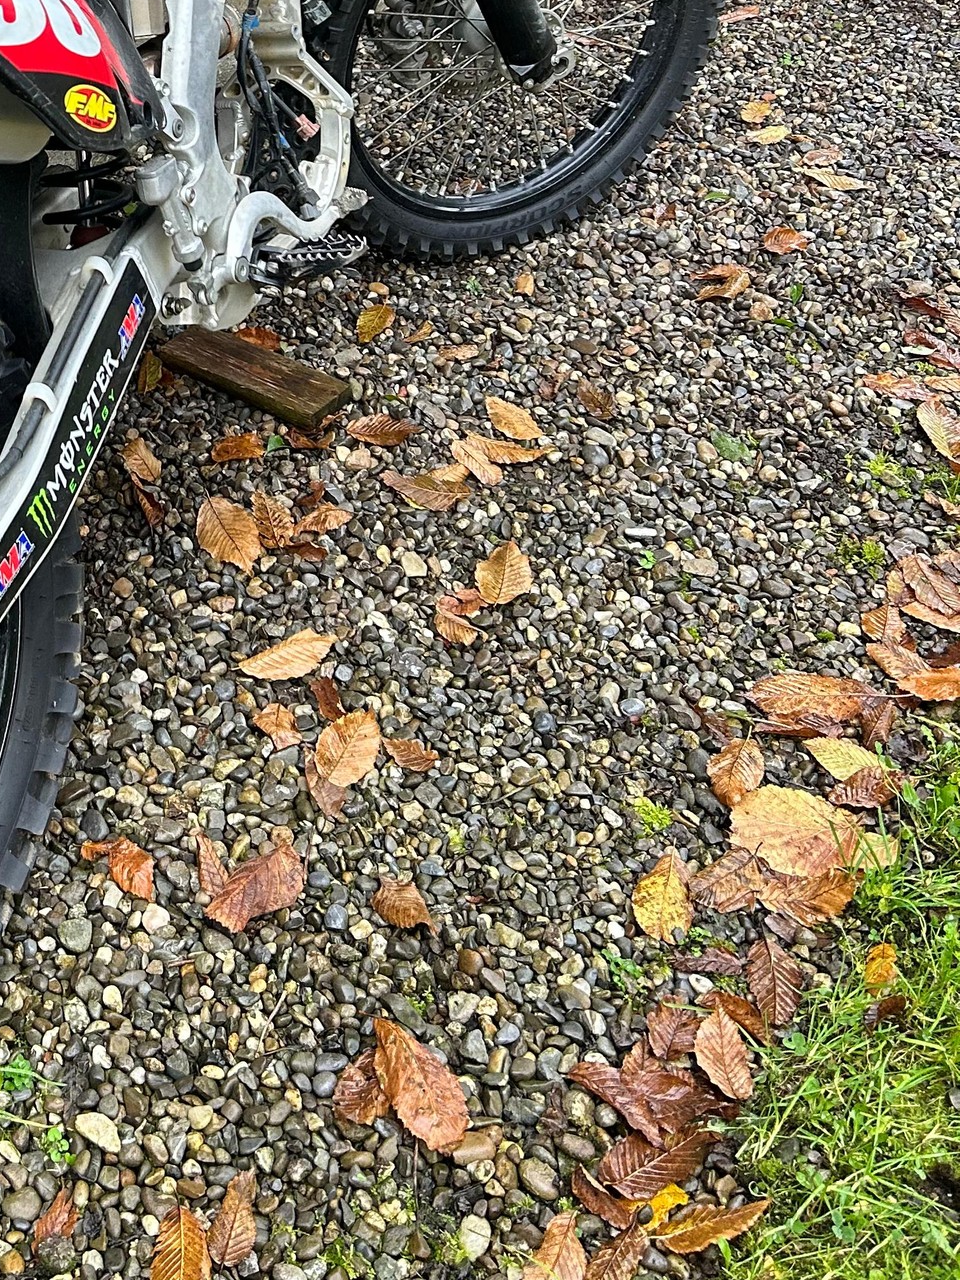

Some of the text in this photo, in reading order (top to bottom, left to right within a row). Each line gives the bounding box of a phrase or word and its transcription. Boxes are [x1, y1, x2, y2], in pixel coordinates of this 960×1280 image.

[65, 91, 116, 123] FMF
[117, 293, 146, 362] AMA
[69, 388, 117, 495] ENERGY
